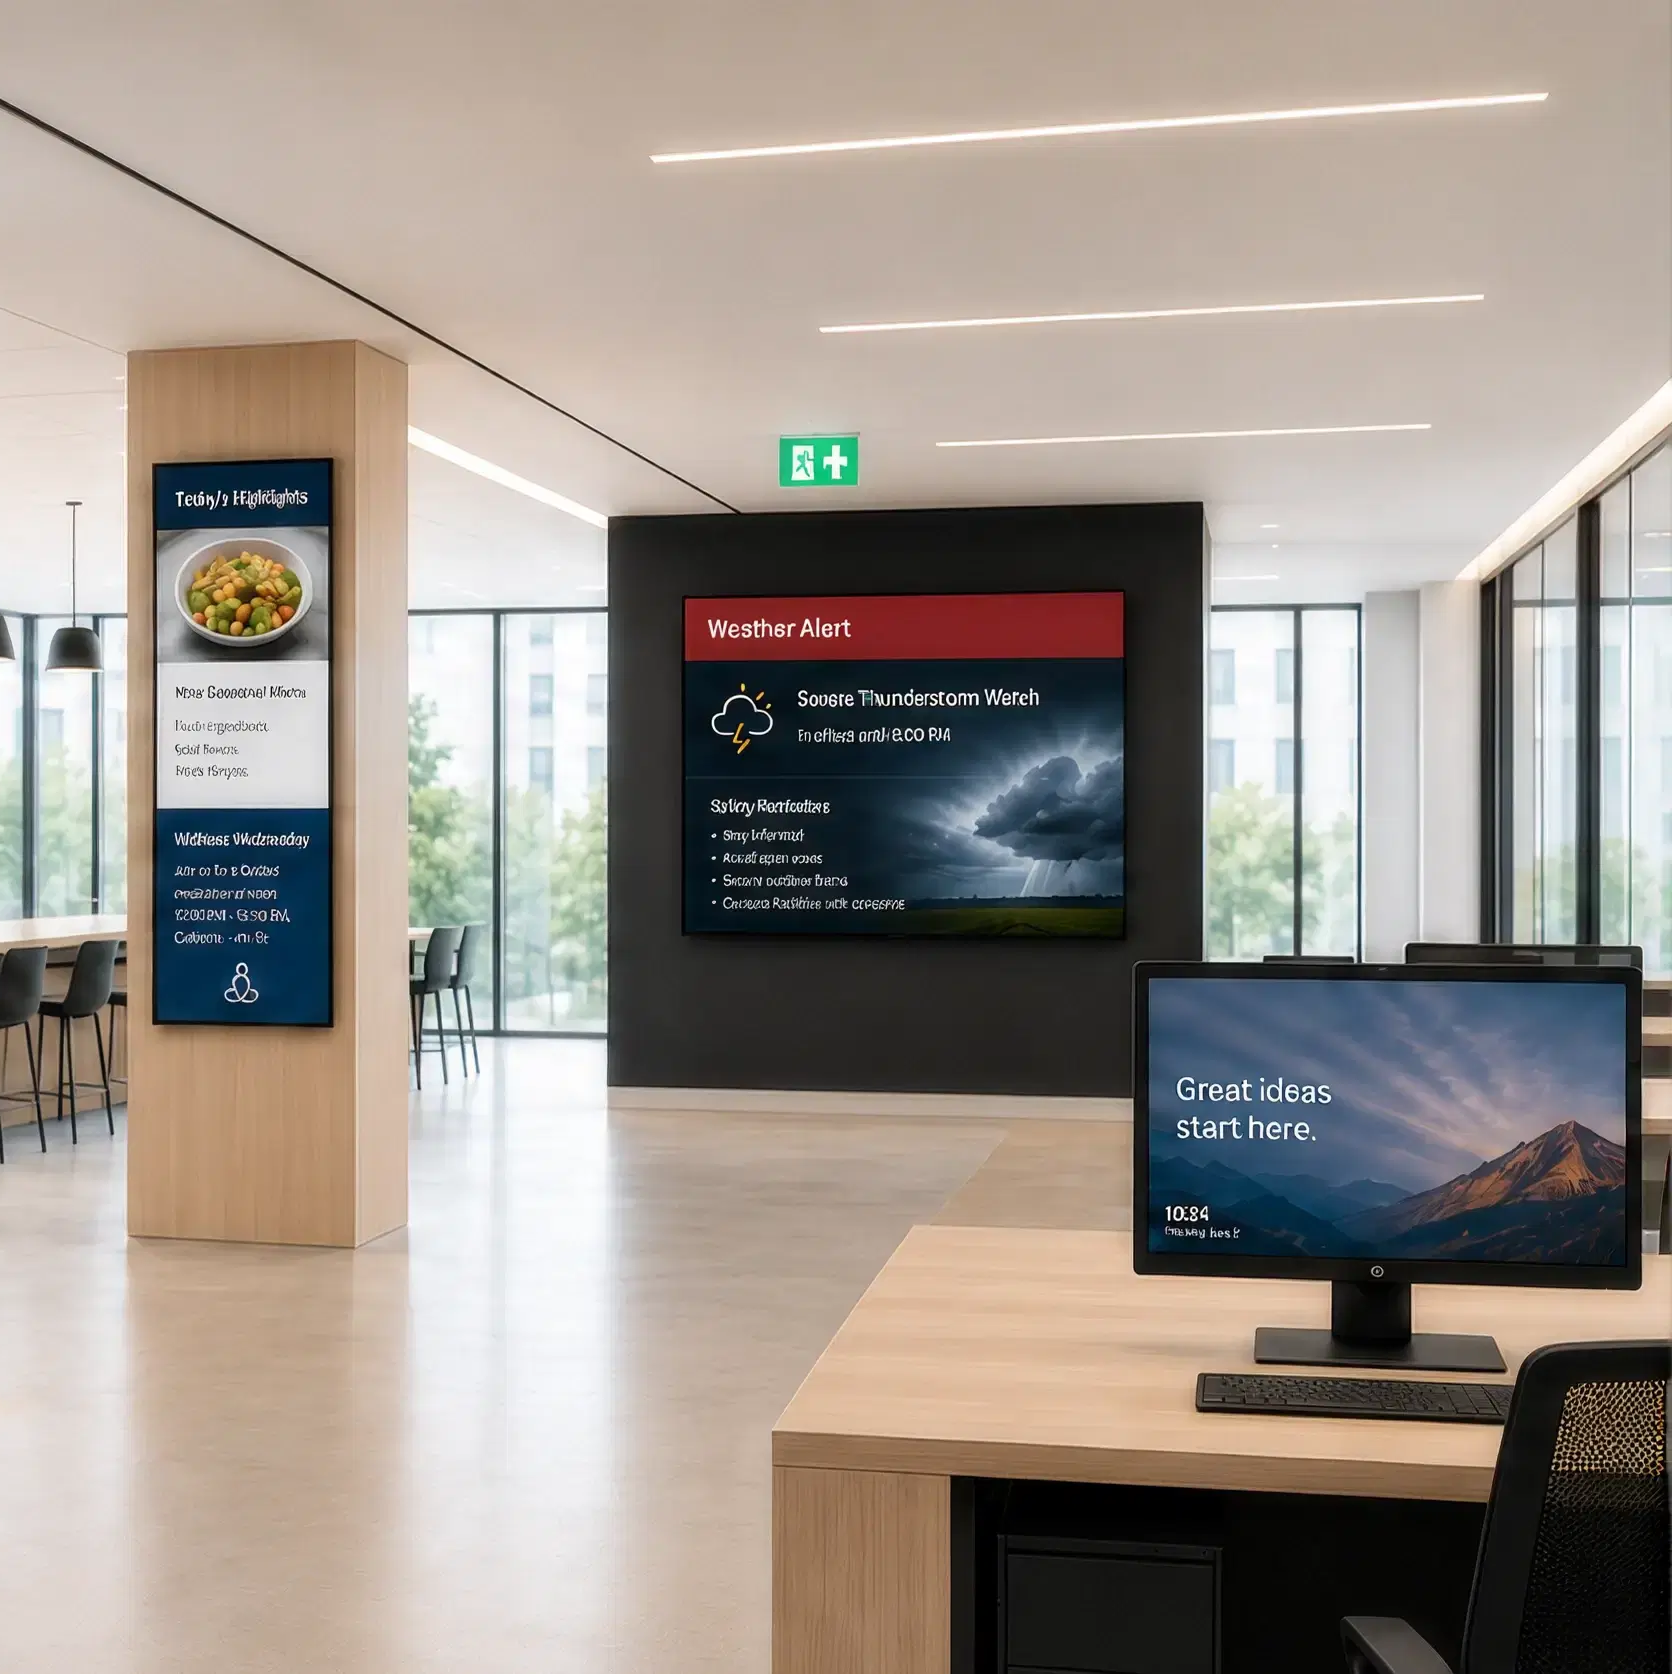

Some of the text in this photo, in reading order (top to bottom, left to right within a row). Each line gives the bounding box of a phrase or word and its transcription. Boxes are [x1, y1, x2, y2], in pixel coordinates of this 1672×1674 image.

[1176, 1076, 1332, 1104] Great ideas
[1176, 1115, 1317, 1142] start here.
